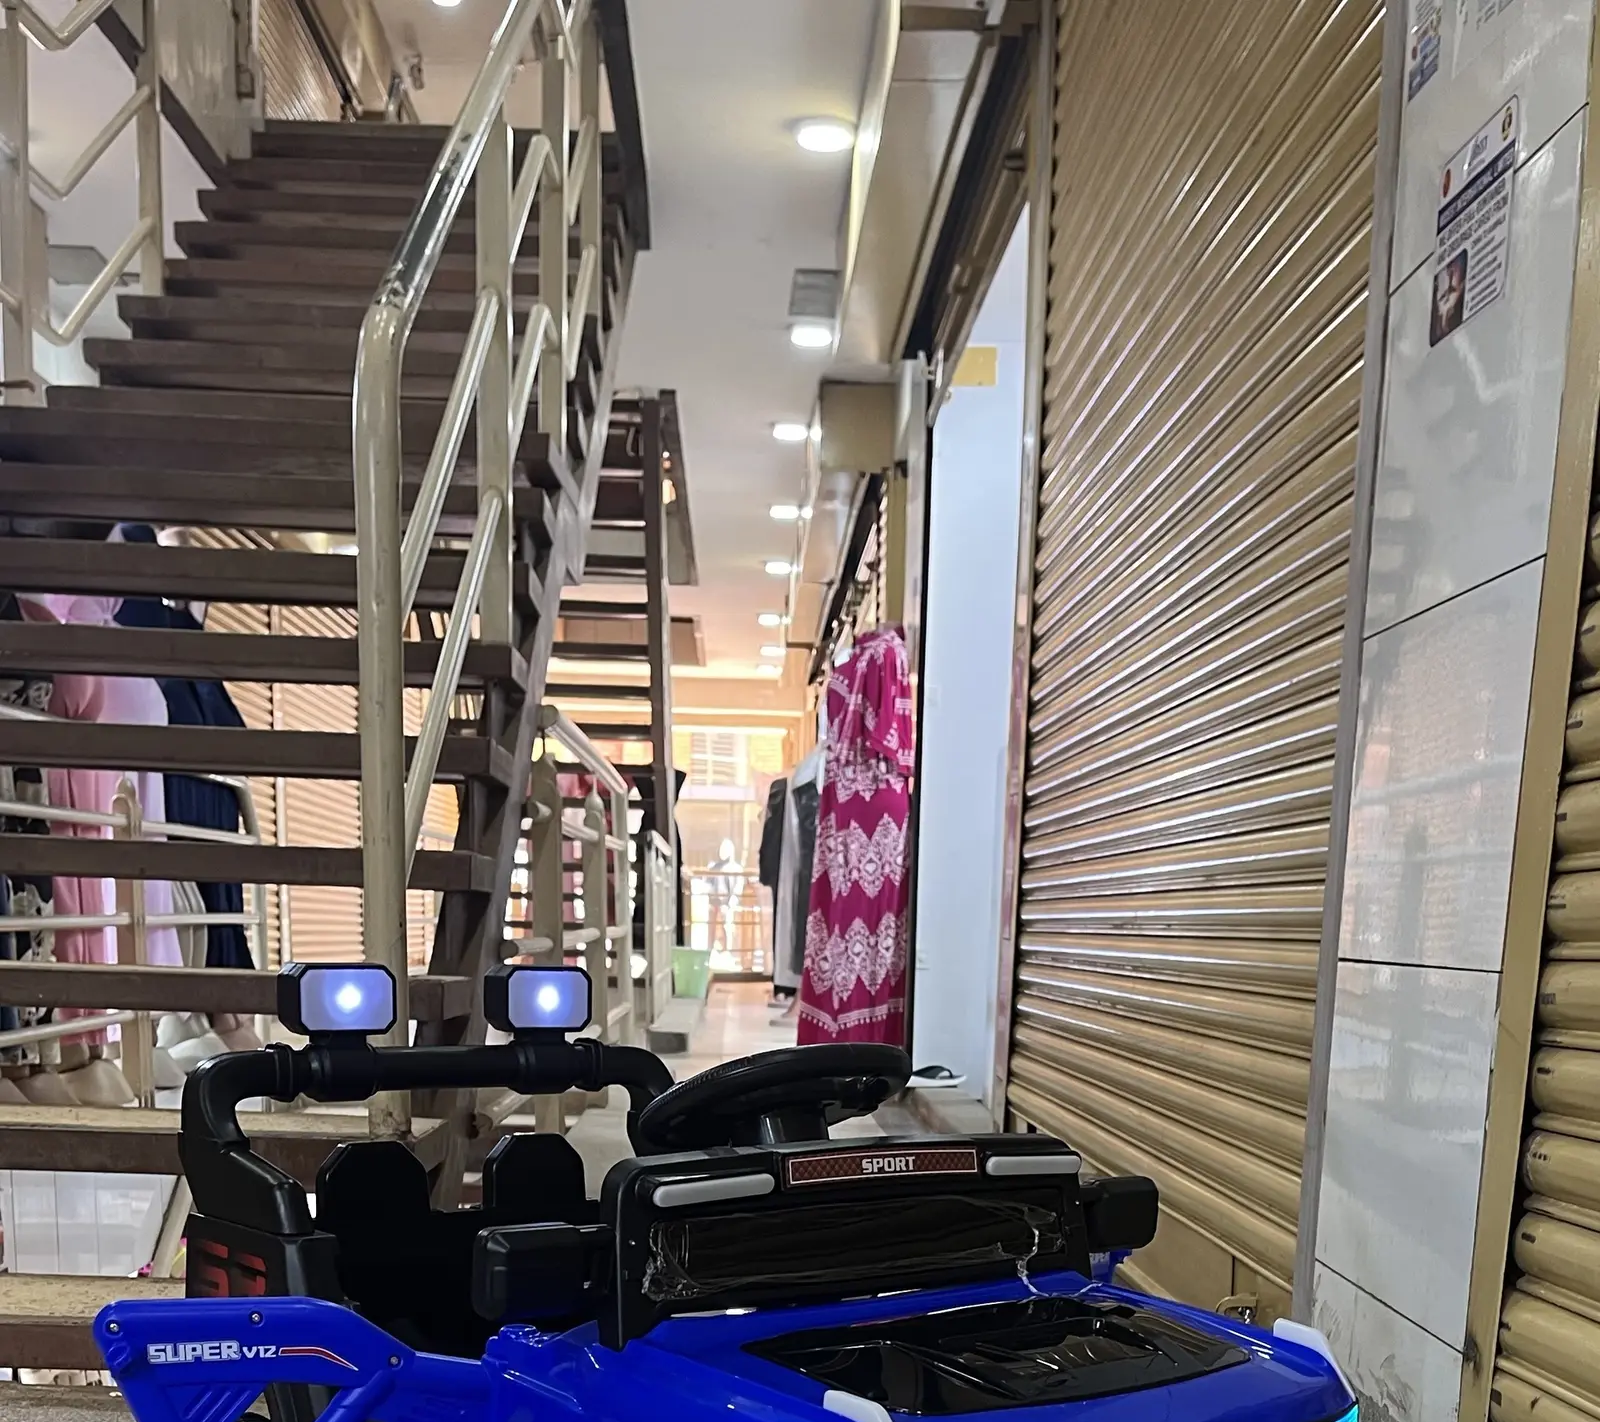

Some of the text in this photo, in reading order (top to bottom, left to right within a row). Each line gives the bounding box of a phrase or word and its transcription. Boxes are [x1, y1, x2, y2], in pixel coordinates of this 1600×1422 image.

[861, 1156, 916, 1173] SPORT
[147, 1341, 277, 1363] SUPER V12
